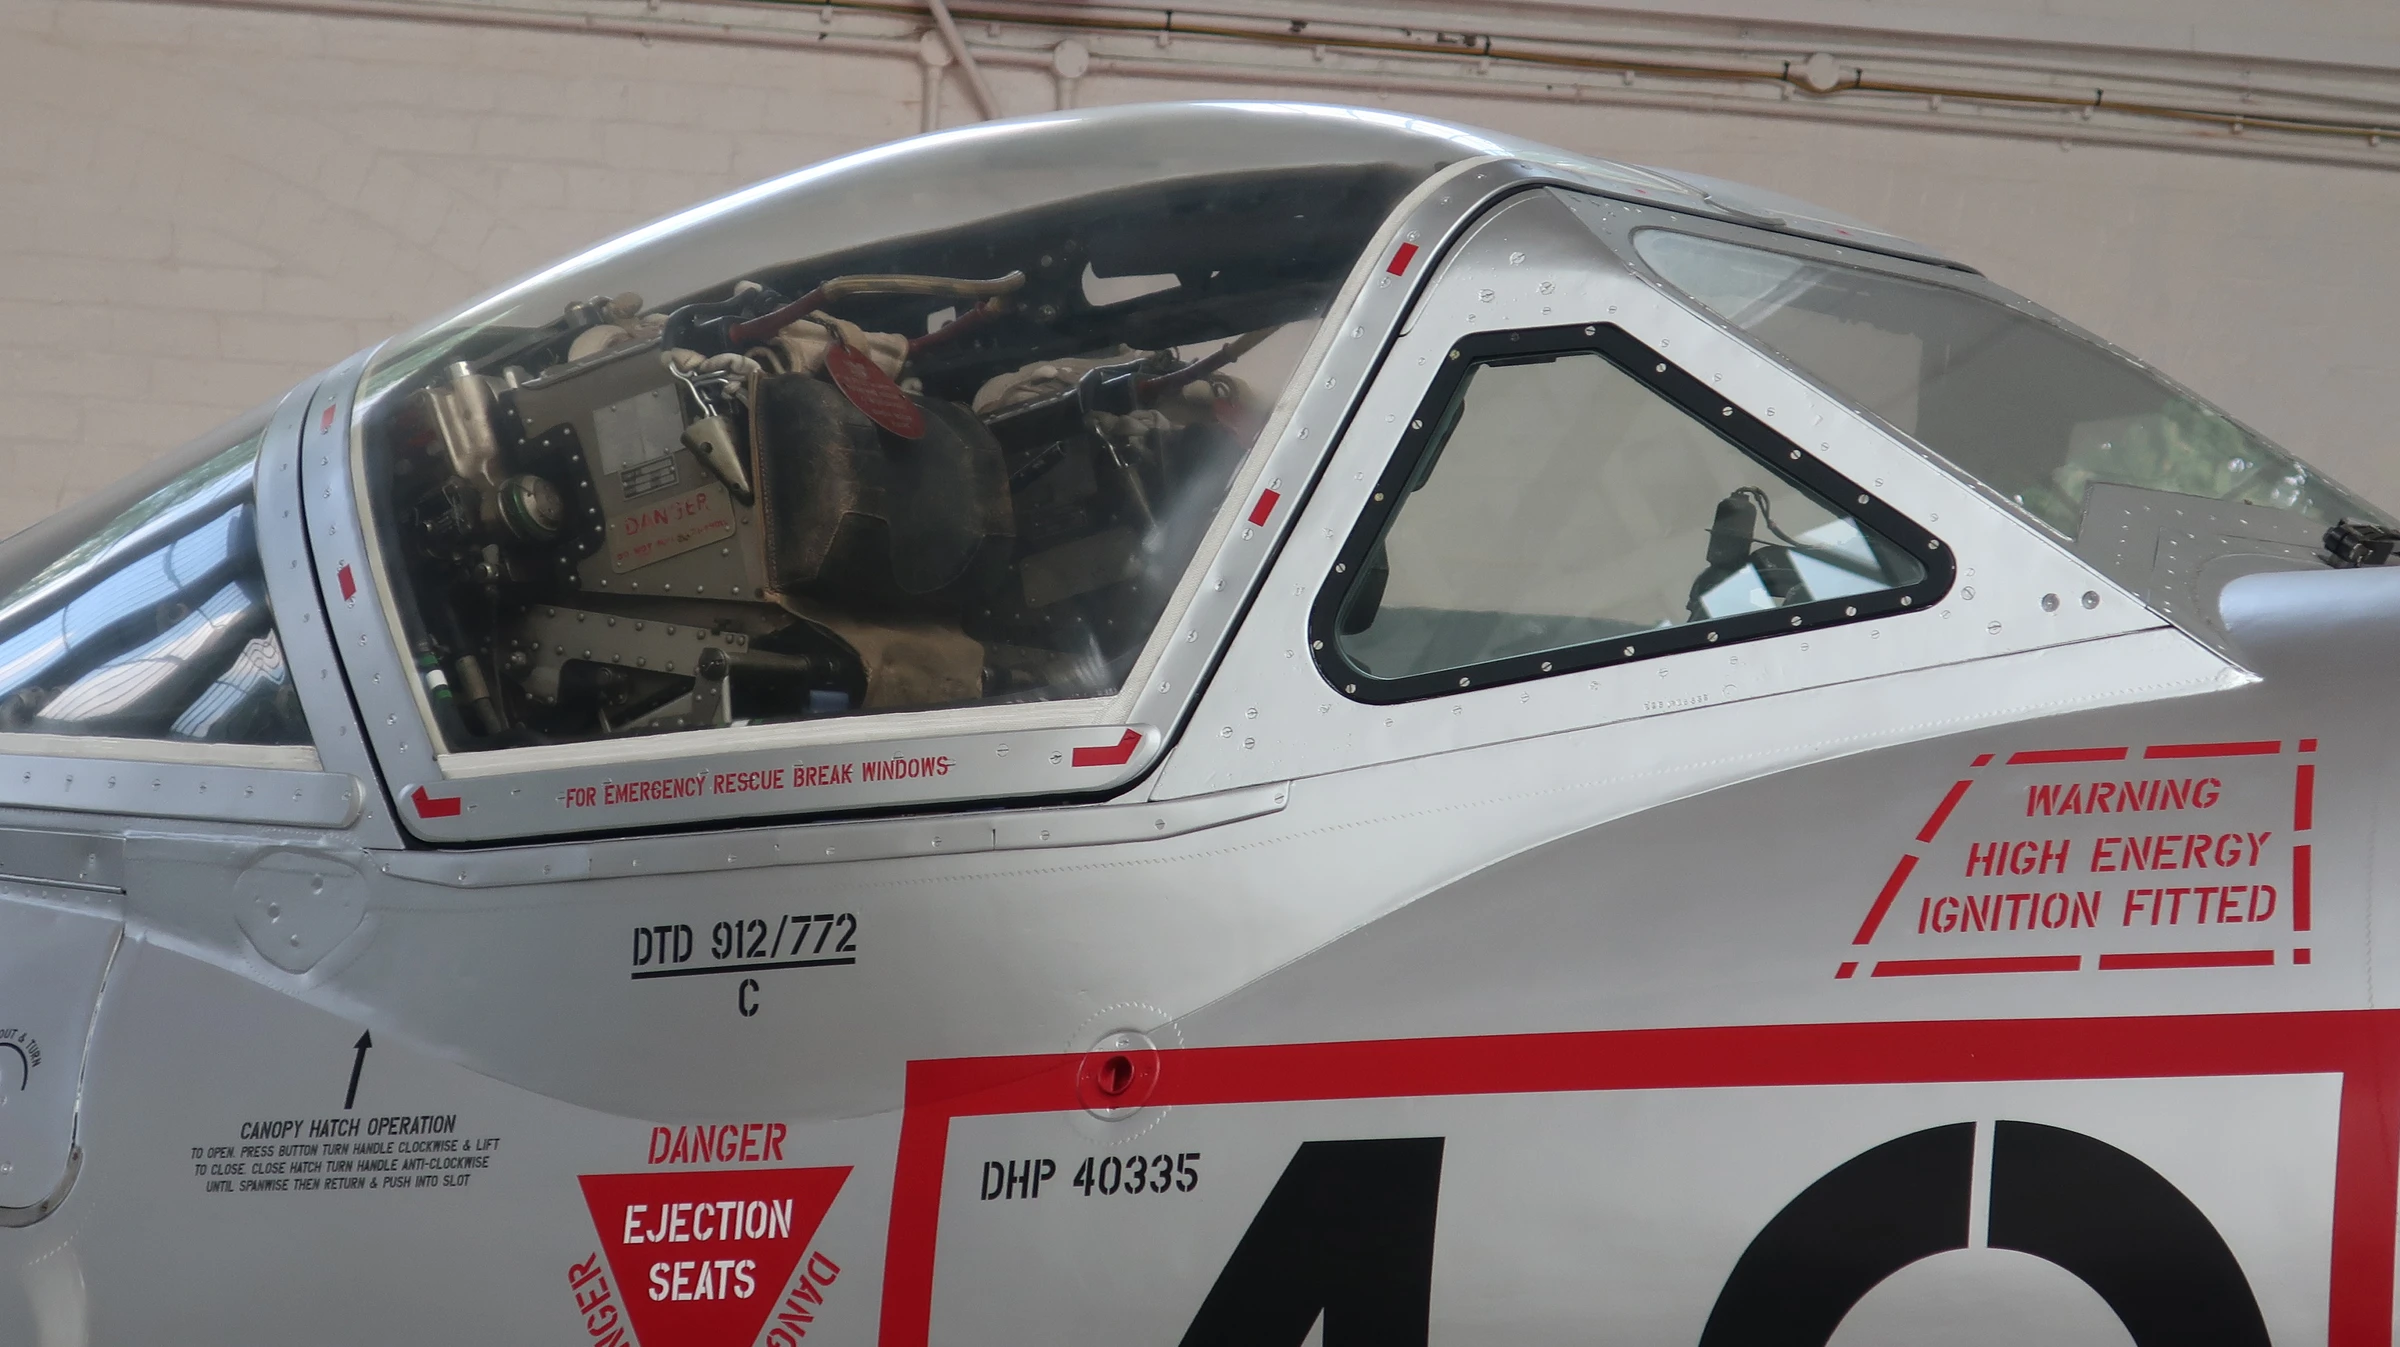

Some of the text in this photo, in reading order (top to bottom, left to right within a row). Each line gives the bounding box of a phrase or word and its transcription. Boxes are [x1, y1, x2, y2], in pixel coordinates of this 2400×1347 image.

[566, 756, 949, 808] FOR EMERGENCY RESCUE BREAK WINDOWS
[2026, 777, 2222, 817] WARNING
[1965, 832, 2272, 877] HIGH ENERGY
[1918, 884, 2277, 934] IGNITION FITTED
[633, 912, 857, 966] DTD 912/772
[738, 979, 759, 1017] C
[18, 1033, 27, 1043] &
[26, 1039, 41, 1067] TURN
[240, 1114, 457, 1140] CANOPY HATCH OPERATION
[648, 1123, 787, 1164] DANGER
[191, 1147, 203, 1159] TO
[240, 1145, 275, 1158] PRESS
[278, 1144, 318, 1157] BUTTON
[322, 1143, 349, 1155] TURN
[353, 1141, 394, 1154] HANDLE
[398, 1139, 459, 1153] CLOCKWISE
[462, 1139, 471, 1151] &
[476, 1138, 500, 1151] LIFT
[195, 1164, 207, 1176] TO
[251, 1162, 286, 1175] CLOSE
[290, 1161, 322, 1173] HATCH
[326, 1160, 353, 1172] TURN
[357, 1158, 399, 1172] HANDLE
[401, 1155, 490, 1170] ANTI-CLOCKWISE
[206, 1173, 471, 1193] UNTIL SPANWISE THEN RETURN & PUSH INTO SLOT
[981, 1153, 1200, 1200] DHP 40335
[623, 1199, 793, 1244] EJECTION
[648, 1260, 756, 1301] SEATS
